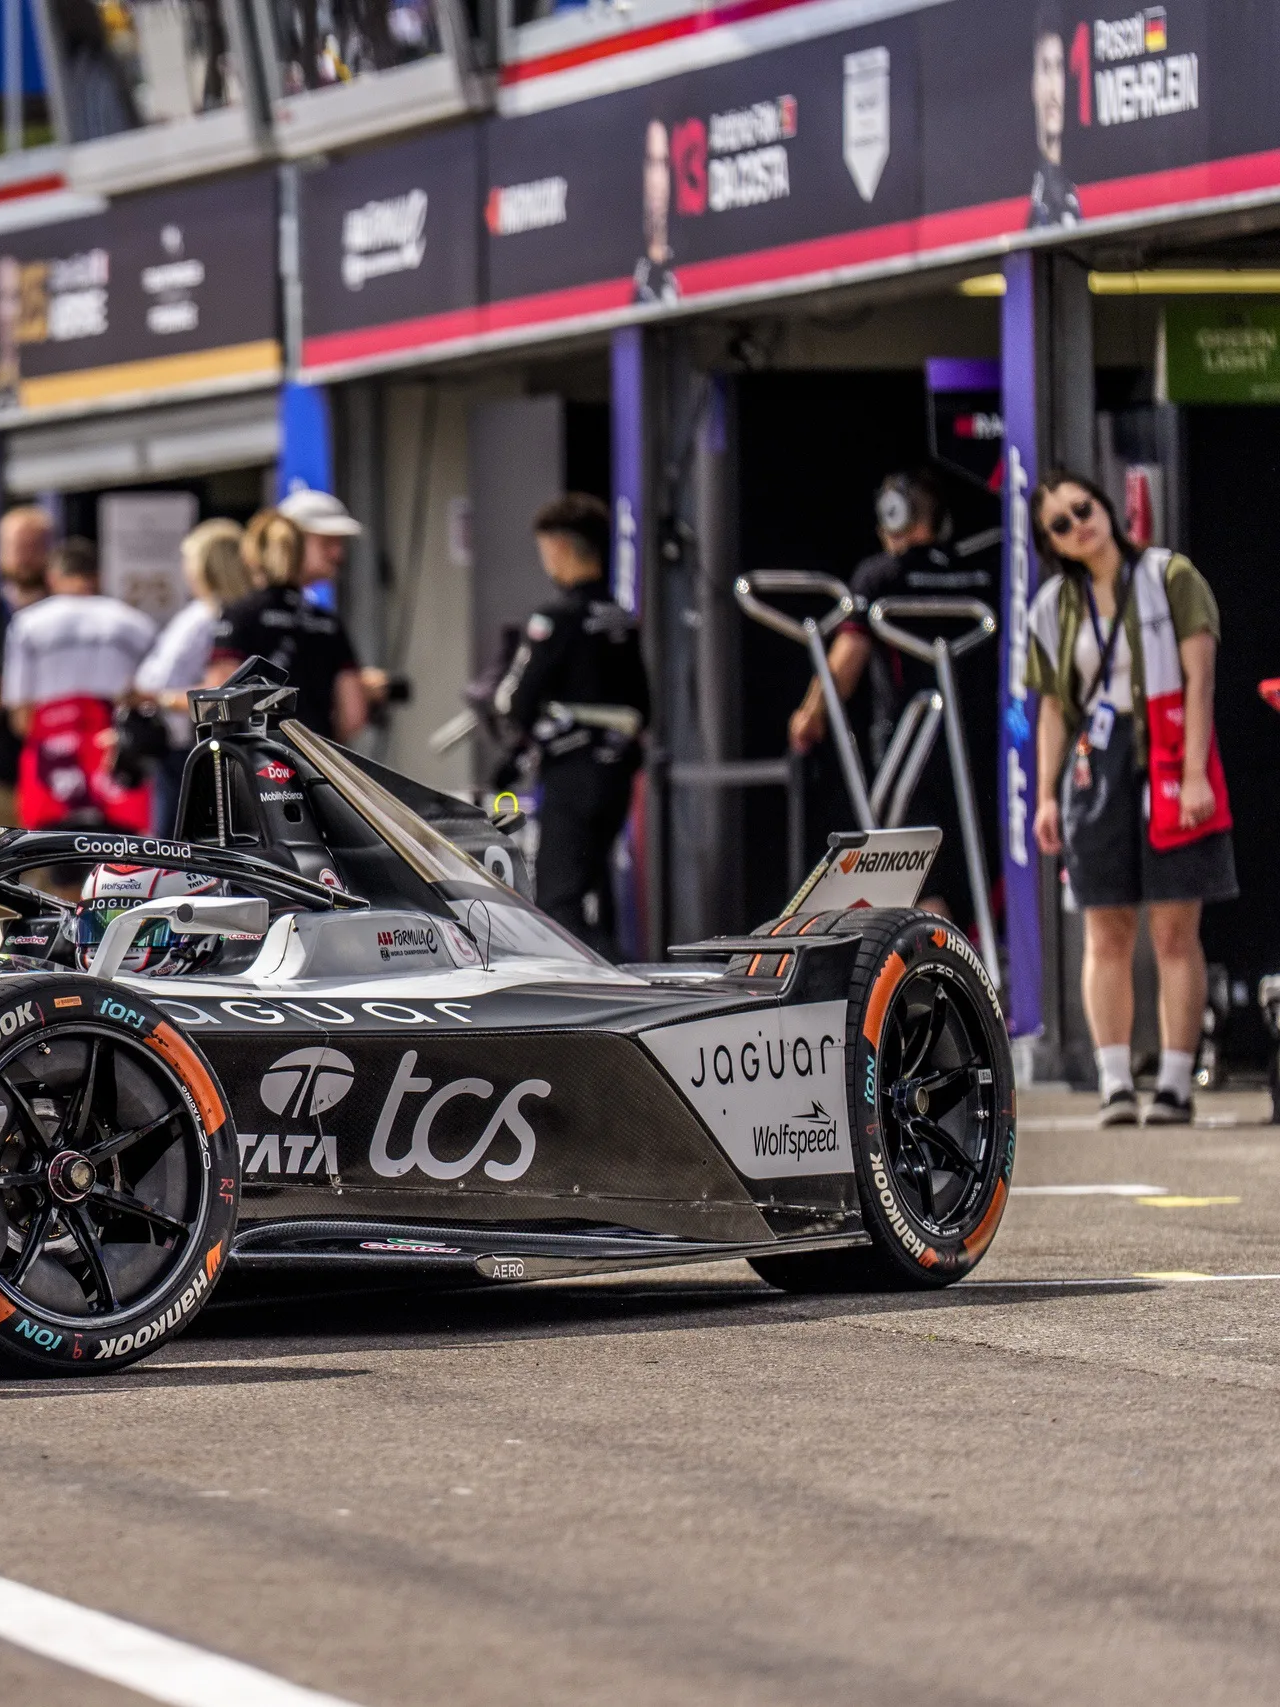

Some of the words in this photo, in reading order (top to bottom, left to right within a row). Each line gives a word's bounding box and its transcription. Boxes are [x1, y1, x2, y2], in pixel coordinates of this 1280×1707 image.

[1072, 21, 1091, 127] 1
[1095, 52, 1199, 126] WEHRLEIN
[74, 836, 138, 858] Google
[143, 839, 192, 859] Cloud
[368, 1049, 552, 1182] tcs
[238, 1133, 339, 1175] TATA
[492, 1263, 524, 1279] AERO
